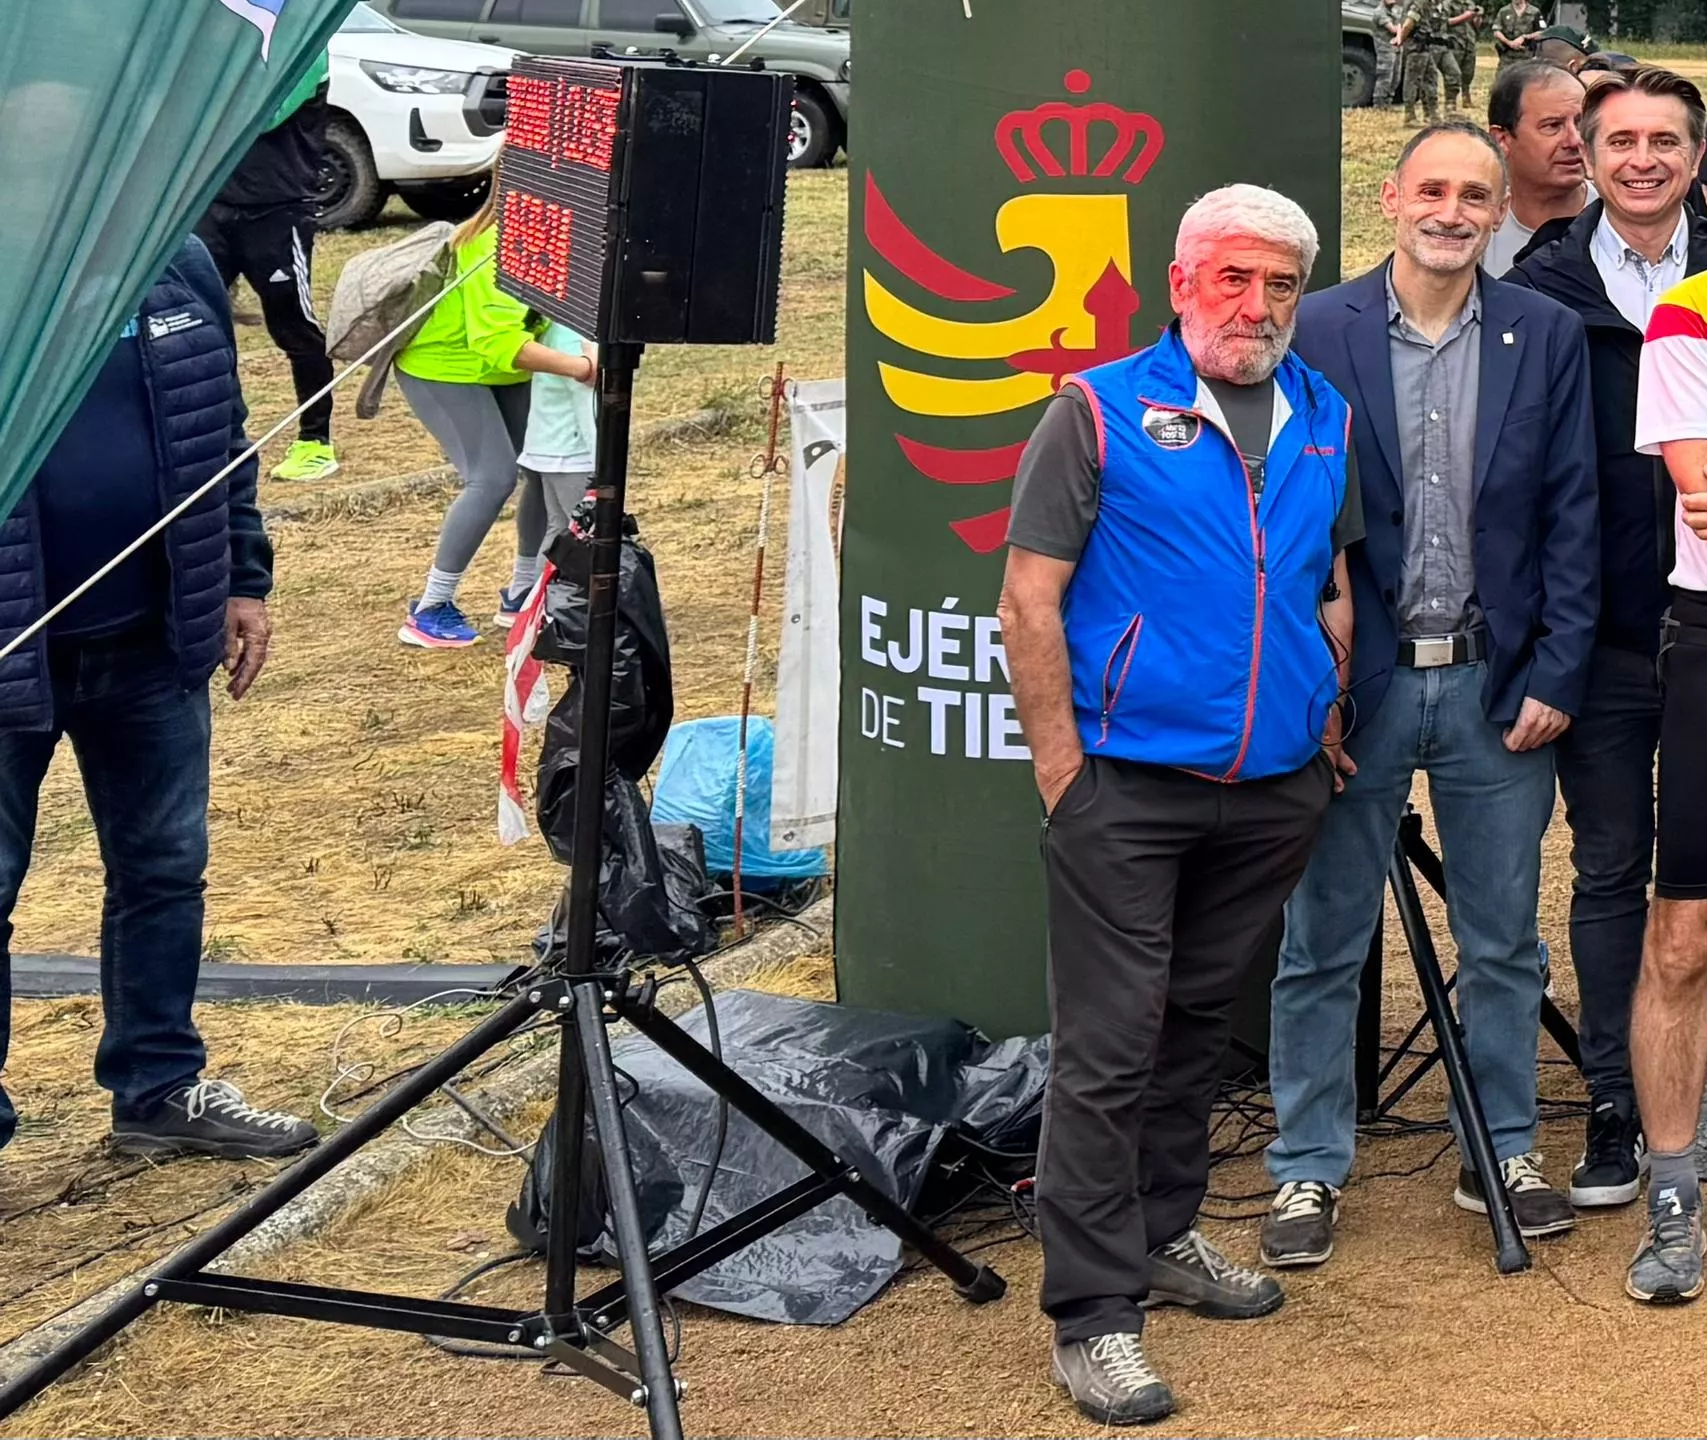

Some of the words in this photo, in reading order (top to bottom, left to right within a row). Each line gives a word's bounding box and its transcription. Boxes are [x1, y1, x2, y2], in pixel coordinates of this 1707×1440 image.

[861, 595, 1012, 683] EJÉR
[861, 687, 905, 748] DE
[917, 686, 1034, 760] TIE
